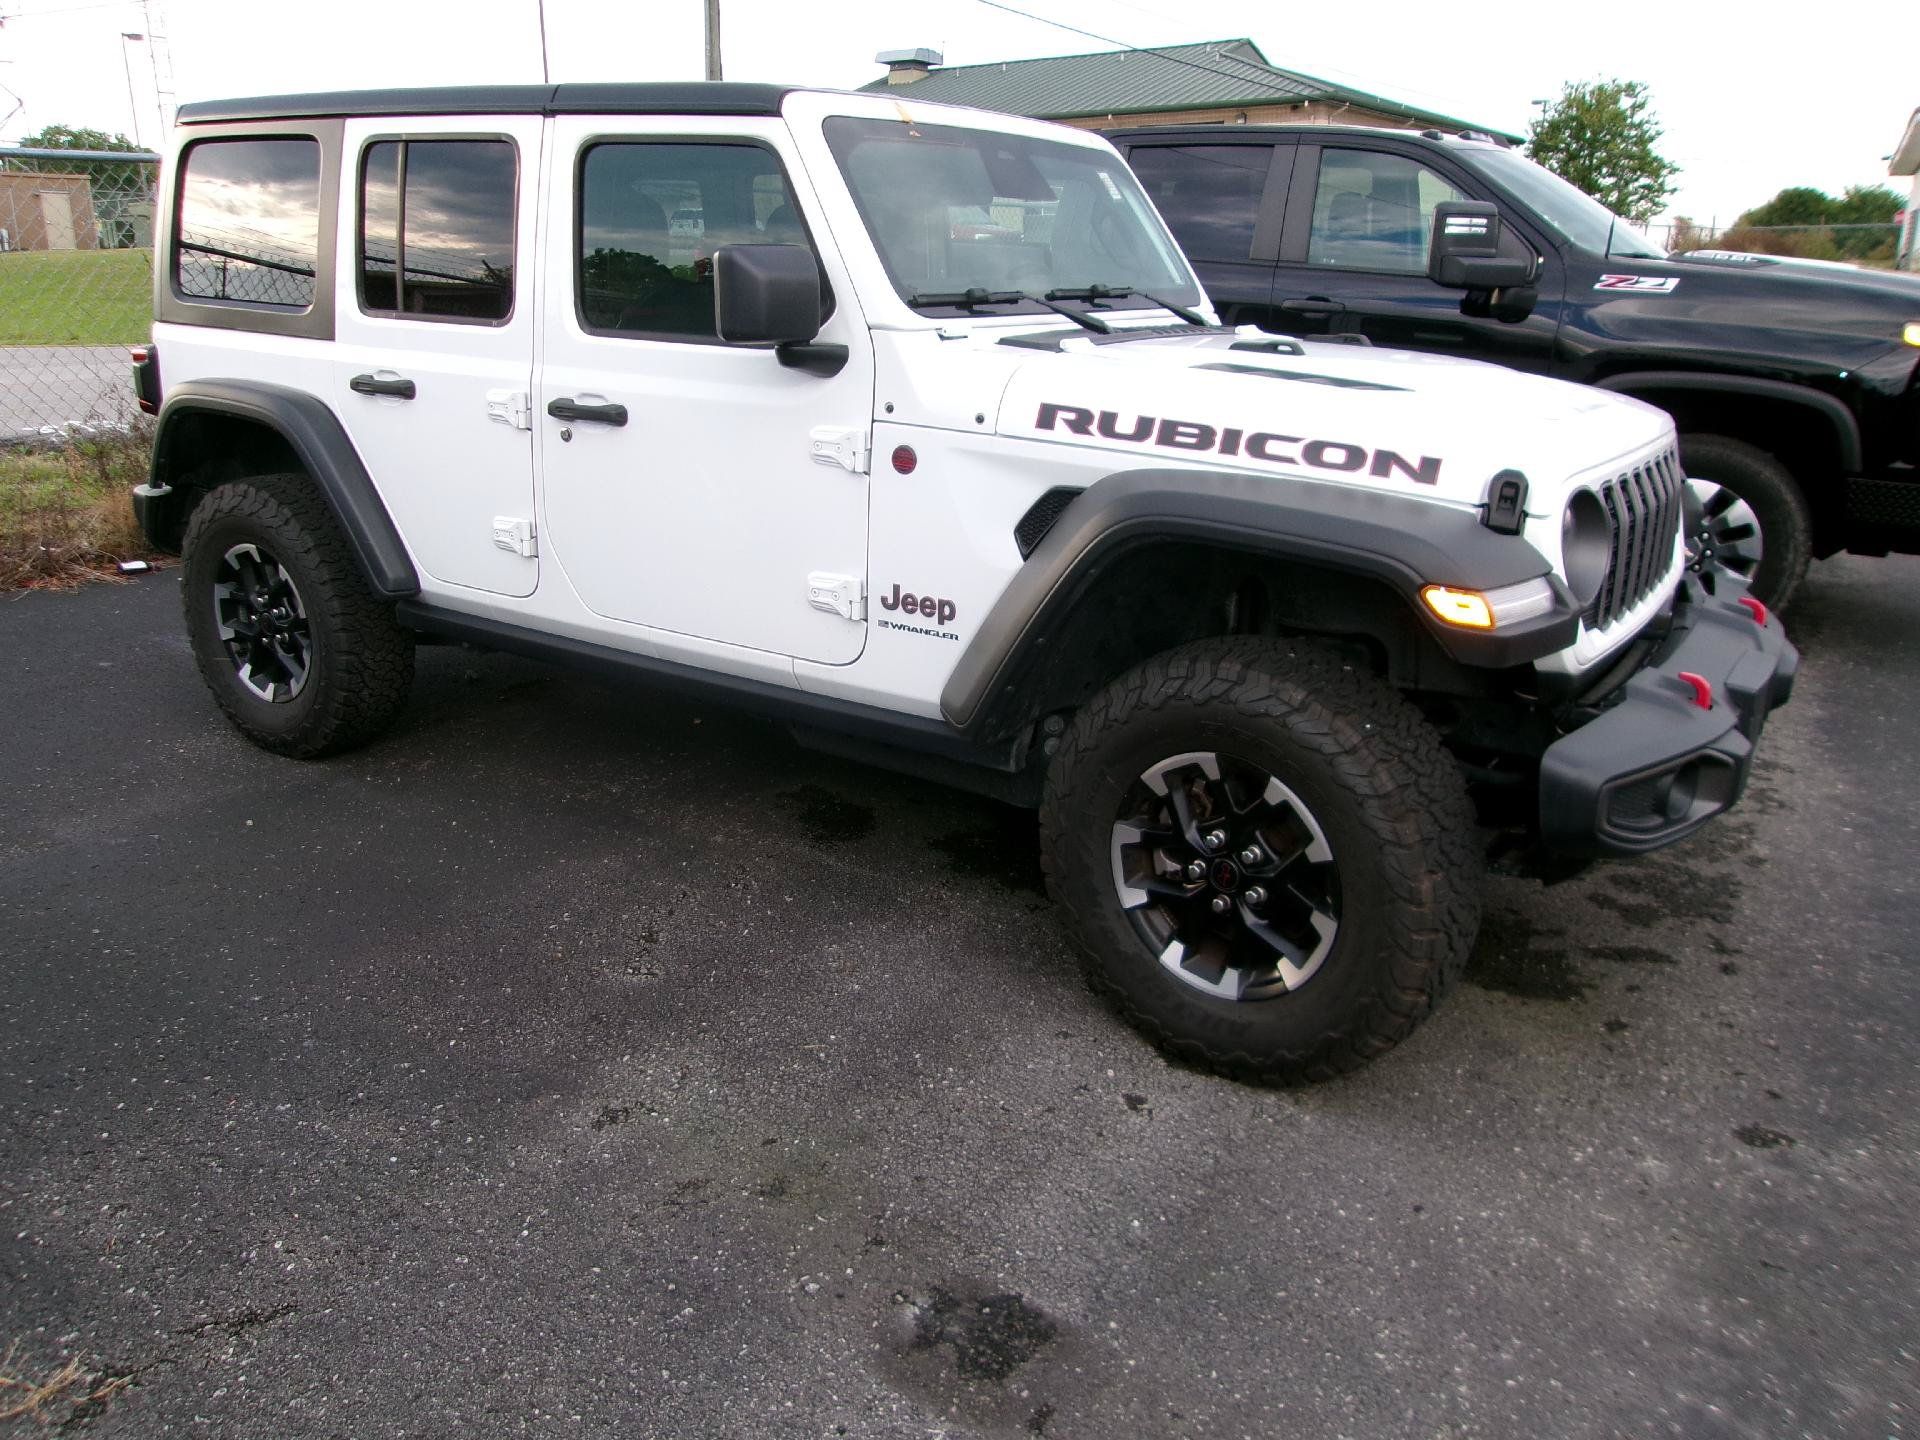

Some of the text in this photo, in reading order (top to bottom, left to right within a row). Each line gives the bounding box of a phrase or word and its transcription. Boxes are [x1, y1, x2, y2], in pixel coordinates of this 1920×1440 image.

[1034, 402, 1443, 486] RUBICON
[880, 583, 957, 626] Jeep
[889, 621, 960, 641] WRANGLER
